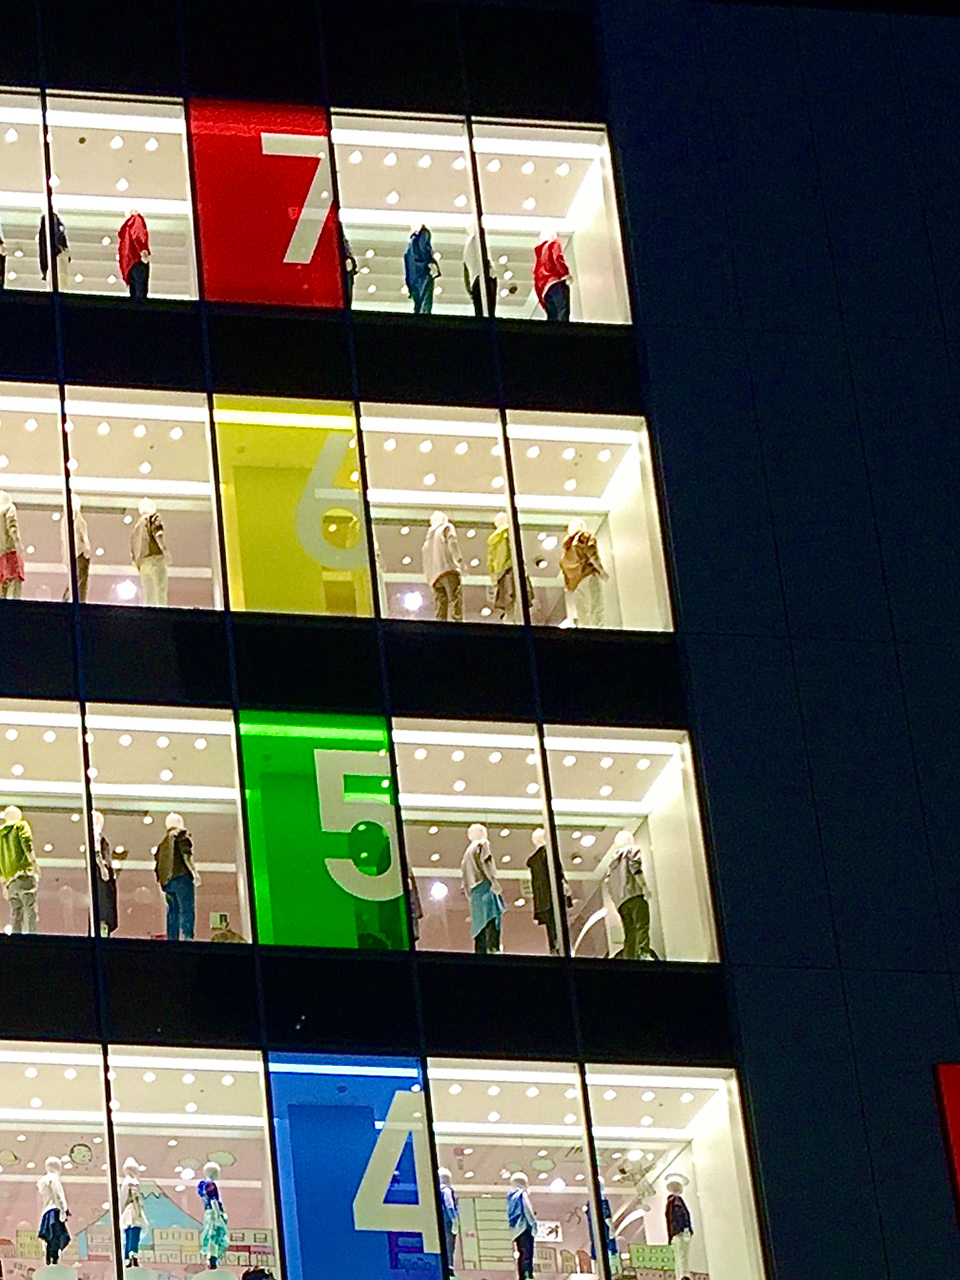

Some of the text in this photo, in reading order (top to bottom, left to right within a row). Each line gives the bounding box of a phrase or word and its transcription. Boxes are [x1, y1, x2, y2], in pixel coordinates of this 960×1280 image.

[261, 132, 334, 264] 7
[296, 432, 371, 570] 6
[314, 748, 404, 902] 5
[353, 1090, 441, 1254] 4
